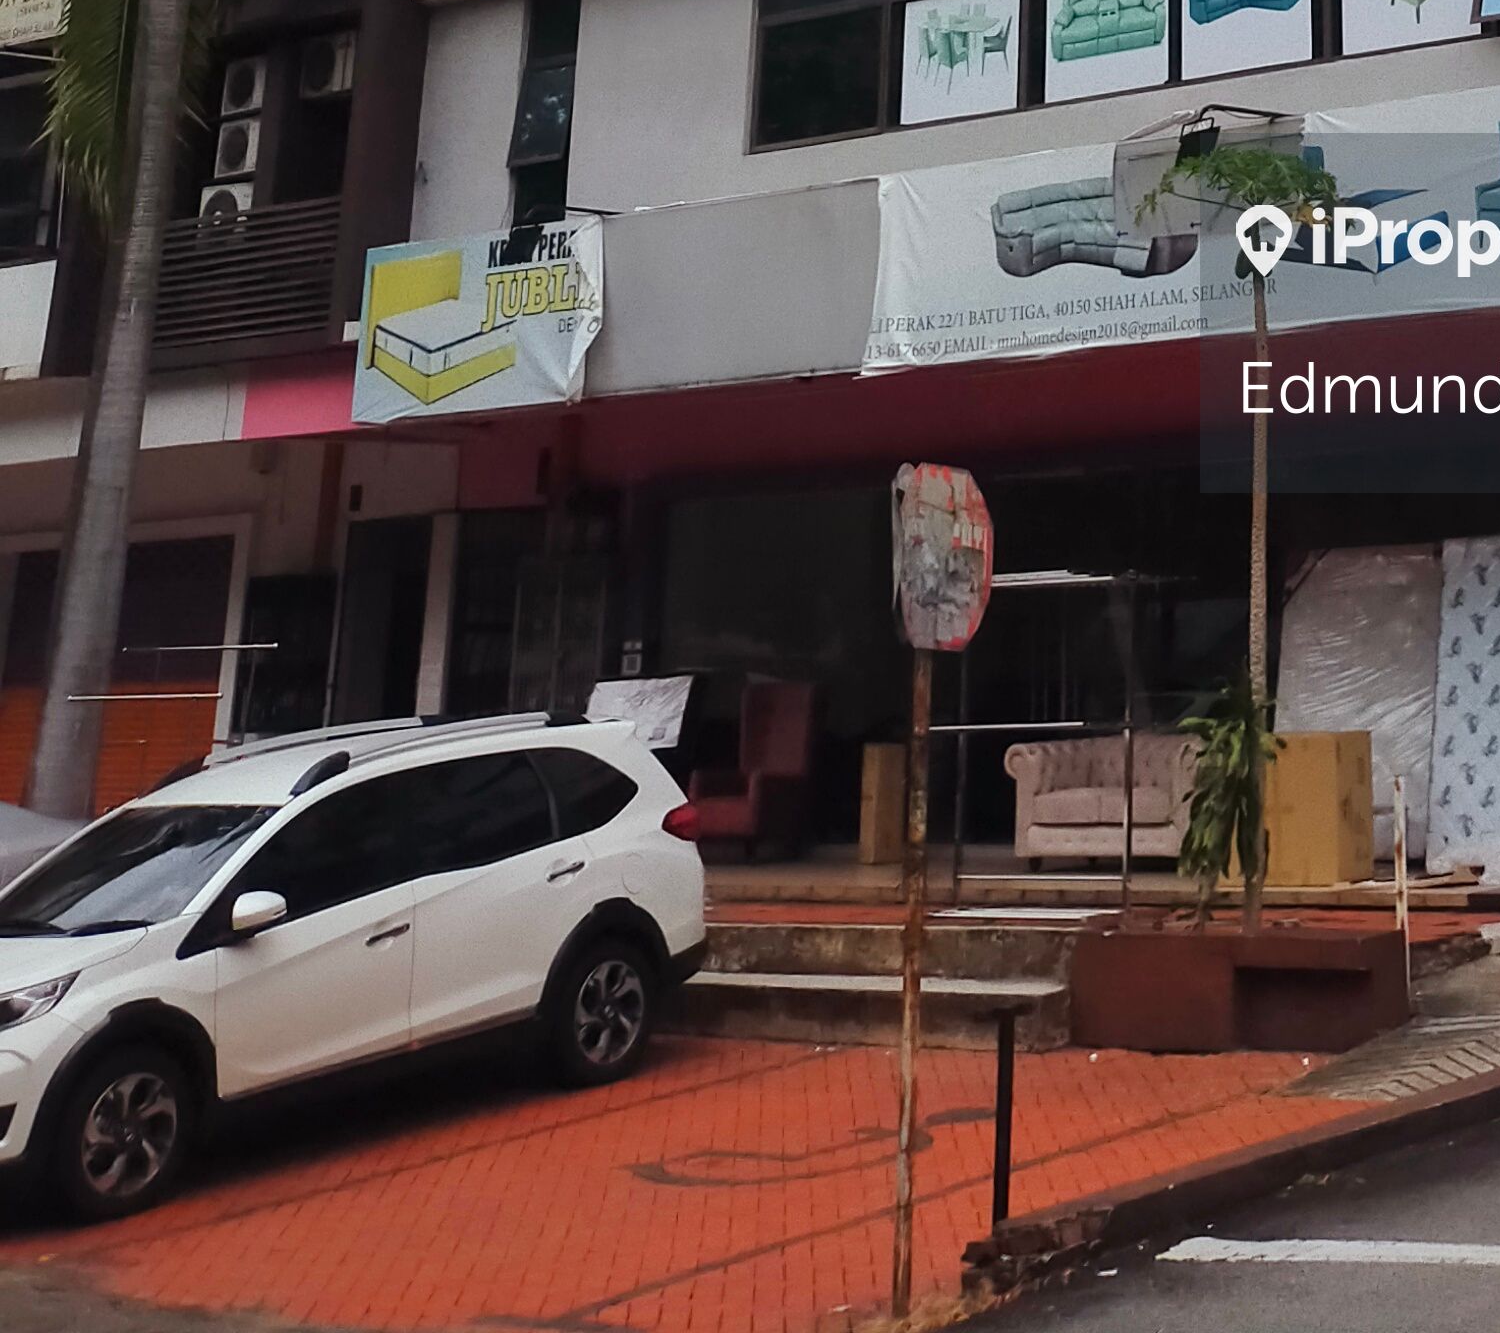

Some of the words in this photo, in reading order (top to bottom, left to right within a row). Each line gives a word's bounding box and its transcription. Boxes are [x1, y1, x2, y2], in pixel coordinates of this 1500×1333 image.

[886, 314, 936, 334] PERAK
[938, 312, 965, 329] 22/1
[969, 307, 1006, 325] BATU
[1010, 304, 1050, 322] TIGA,
[1053, 299, 1090, 317] 40150
[1094, 293, 1136, 313] SHAH
[1139, 288, 1188, 308] ALAM,
[1192, 278, 1278, 302] SELANGR
